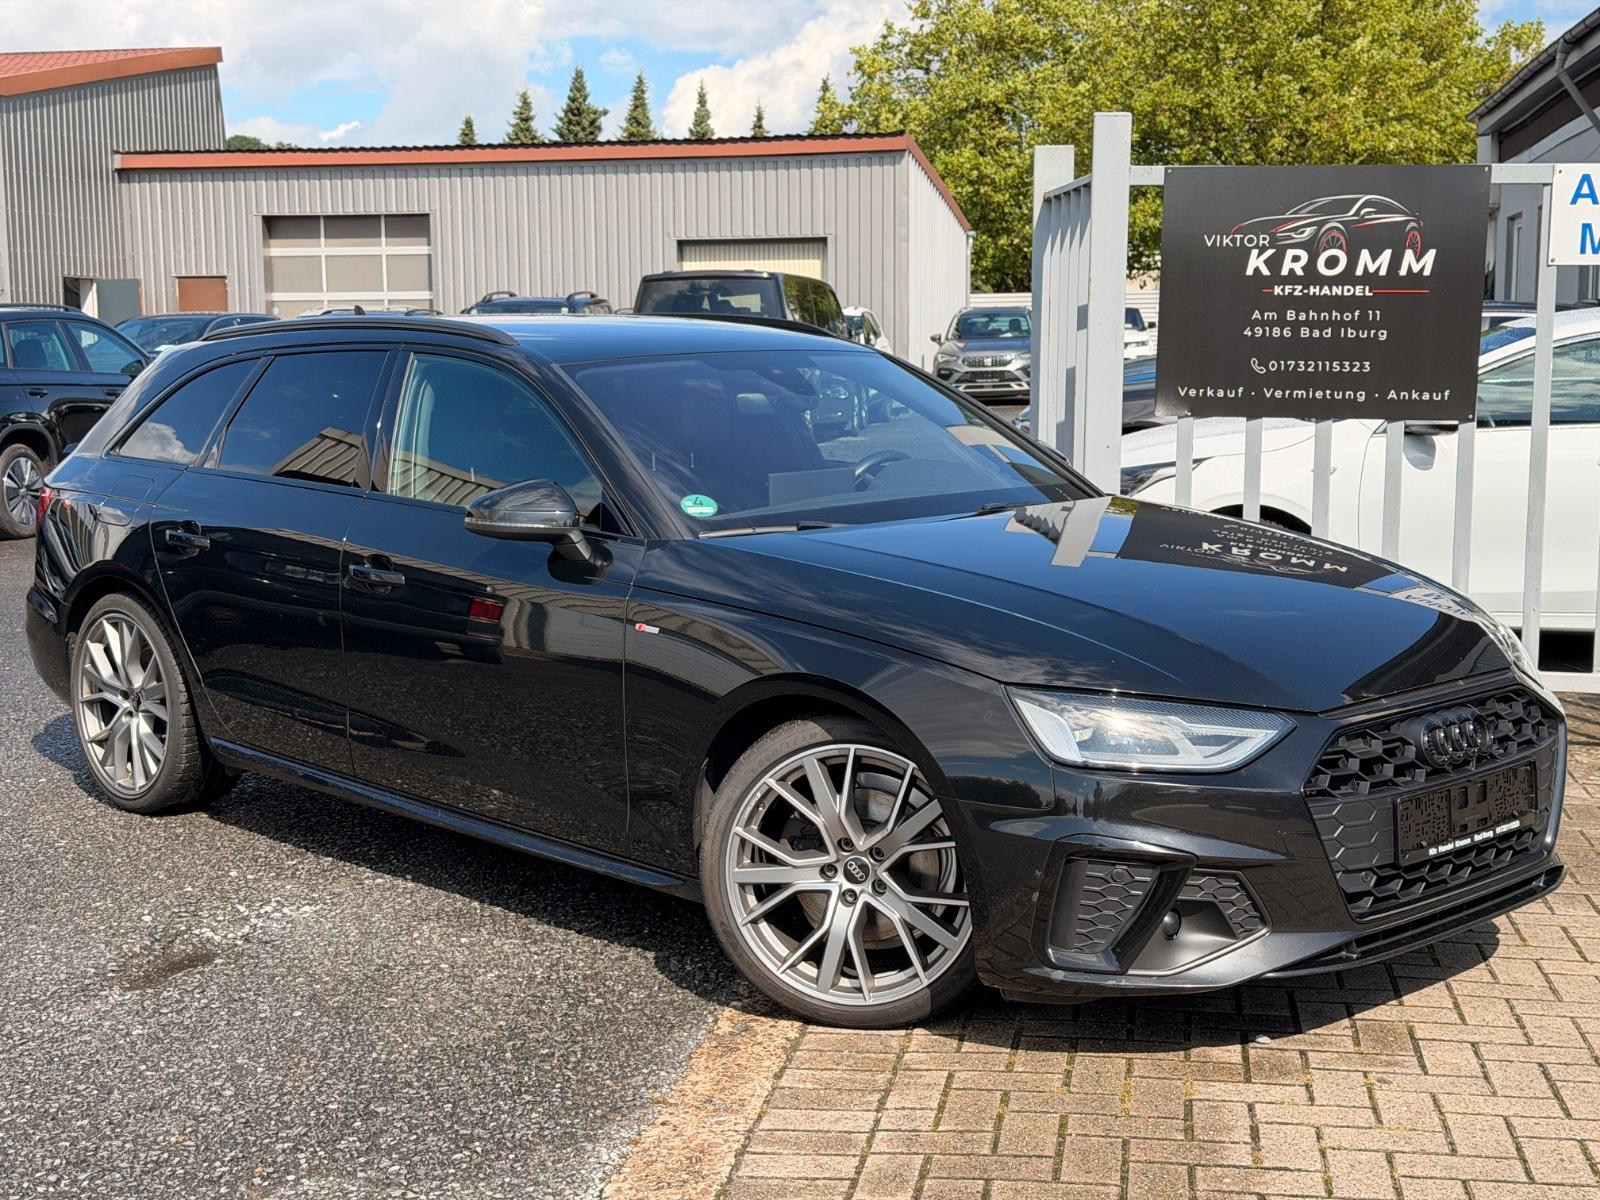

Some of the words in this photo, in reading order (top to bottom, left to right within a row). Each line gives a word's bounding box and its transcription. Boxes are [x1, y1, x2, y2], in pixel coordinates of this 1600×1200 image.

[1203, 233, 1271, 249] VIKTOR
[1244, 247, 1438, 278] KROMM
[1273, 284, 1374, 297] KFZ-HANDEL
[1251, 309, 1278, 321] Am
[1286, 309, 1361, 321] Bahnhof
[1367, 310, 1381, 321] 11
[1243, 326, 1292, 338] 49186
[1300, 326, 1332, 339] Bad
[1340, 327, 1388, 341] Iburg
[1268, 360, 1371, 373] 01732115323
[1177, 386, 1244, 398] Verkauf
[1263, 387, 1366, 402] Vermietung
[1387, 389, 1451, 401] Ankauf
